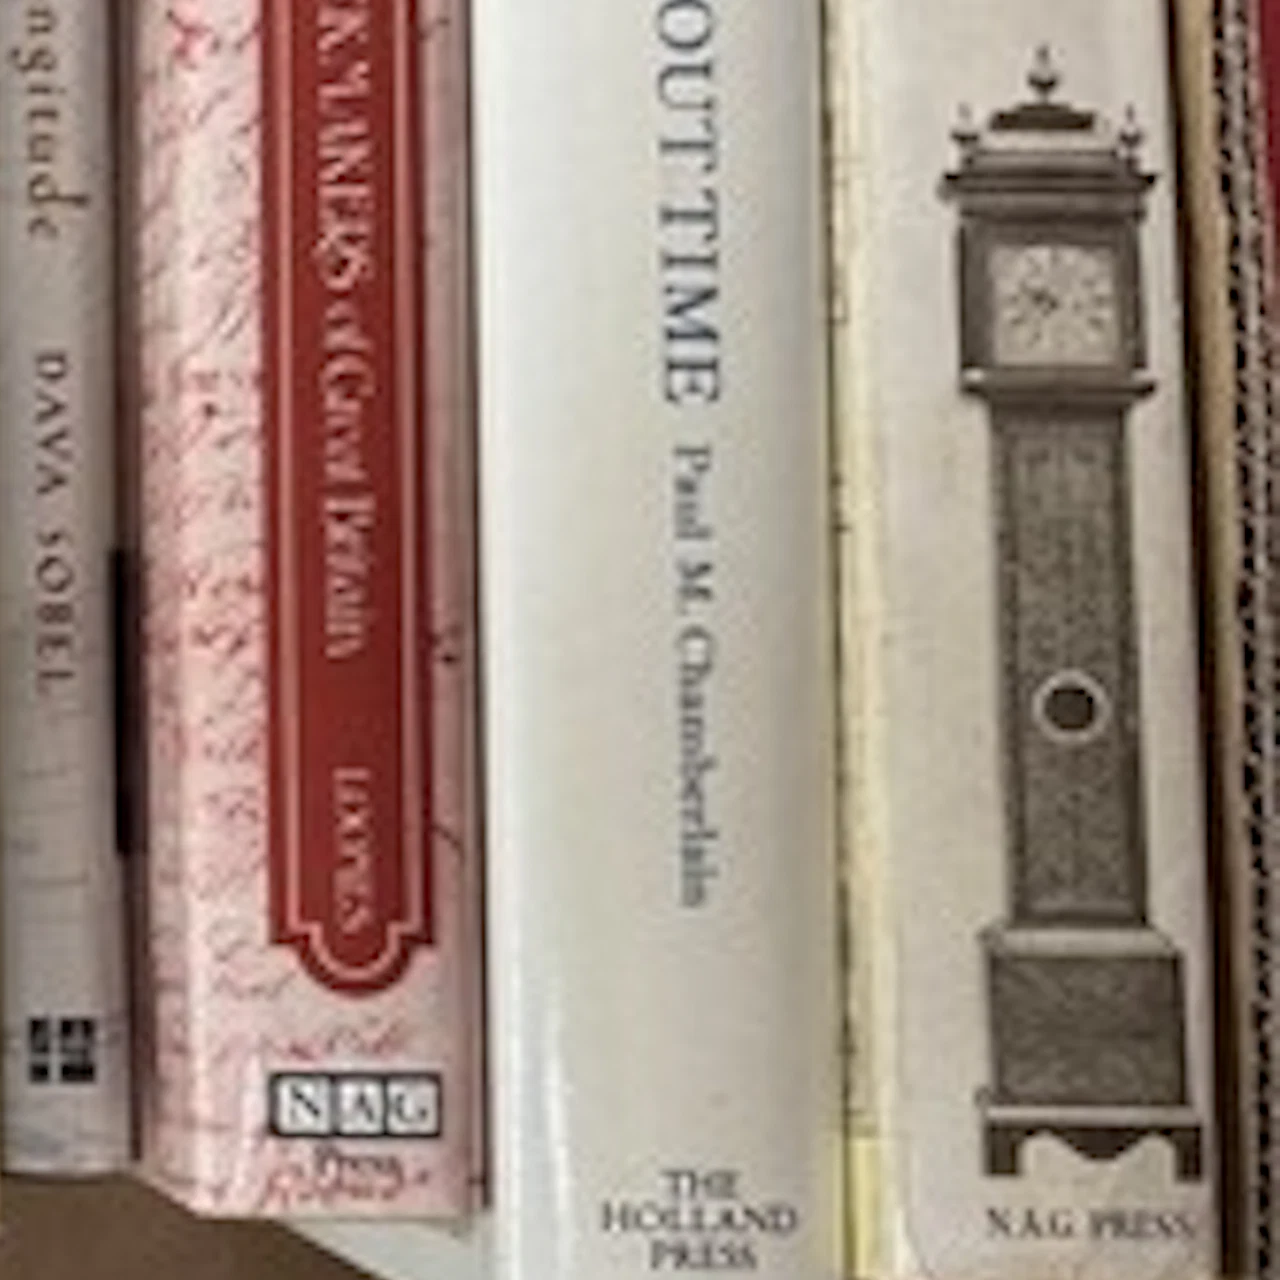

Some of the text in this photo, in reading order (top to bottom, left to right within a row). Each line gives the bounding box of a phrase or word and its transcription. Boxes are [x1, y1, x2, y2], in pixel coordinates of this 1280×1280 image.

[659, 189, 721, 405] TIME
[37, 350, 72, 495] DAVA
[674, 444, 714, 541] Paul
[37, 527, 76, 688] SOBEL
[324, 497, 376, 660] Britain
[677, 627, 720, 909] Chamberlain
[603, 1202, 799, 1235] HOLLAND
[662, 1169, 739, 1197] THE
[1088, 1208, 1196, 1239] PRESS
[649, 1239, 758, 1271] PRESS
